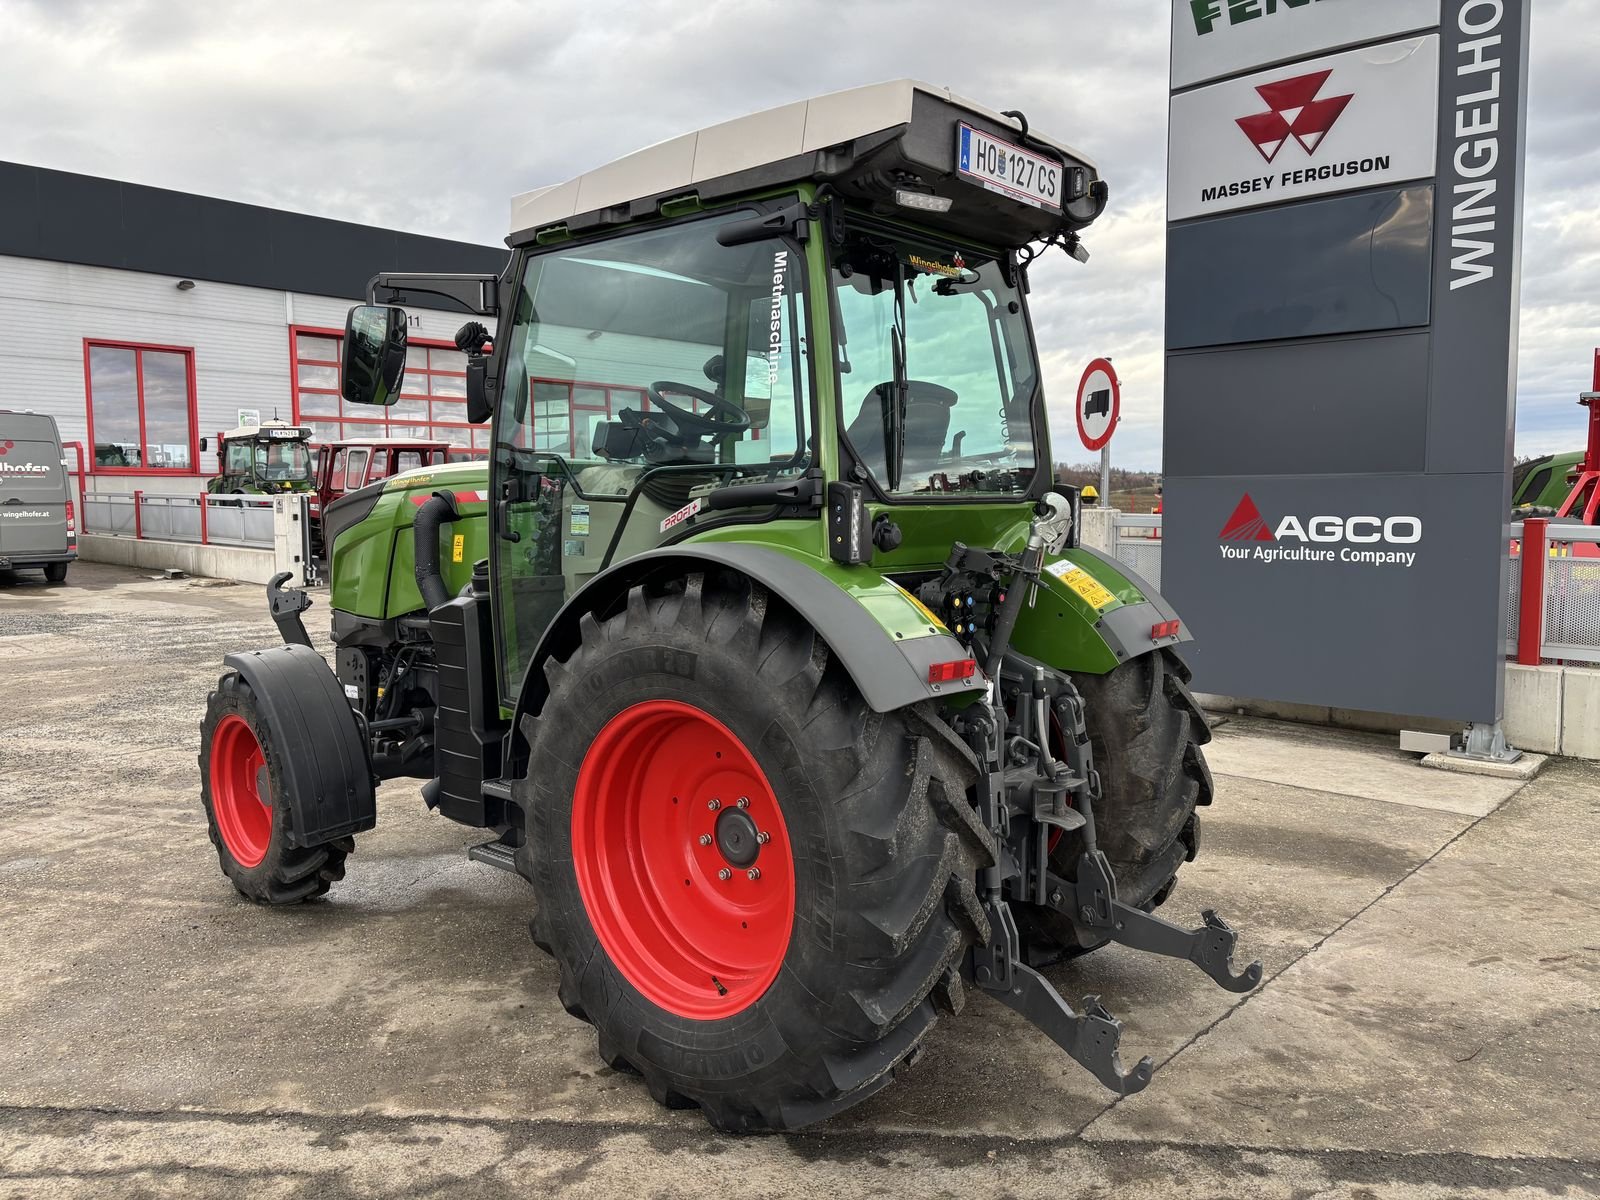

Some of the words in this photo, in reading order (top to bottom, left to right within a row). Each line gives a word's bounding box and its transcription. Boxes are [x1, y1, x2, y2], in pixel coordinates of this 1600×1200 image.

[976, 138, 997, 175] HO
[1009, 153, 1035, 189] 127
[1038, 165, 1056, 198] CS
[1450, 0, 1503, 290] WINGELHO
[1201, 175, 1275, 202] MASSEY
[1281, 155, 1390, 187] FERGUSON
[407, 315, 420, 327] 11
[768, 250, 788, 384] Mietmaschine
[1273, 515, 1422, 544] AGCO
[1219, 545, 1251, 559] Your
[1253, 546, 1336, 563] Agriculture
[1340, 547, 1416, 567] Company
